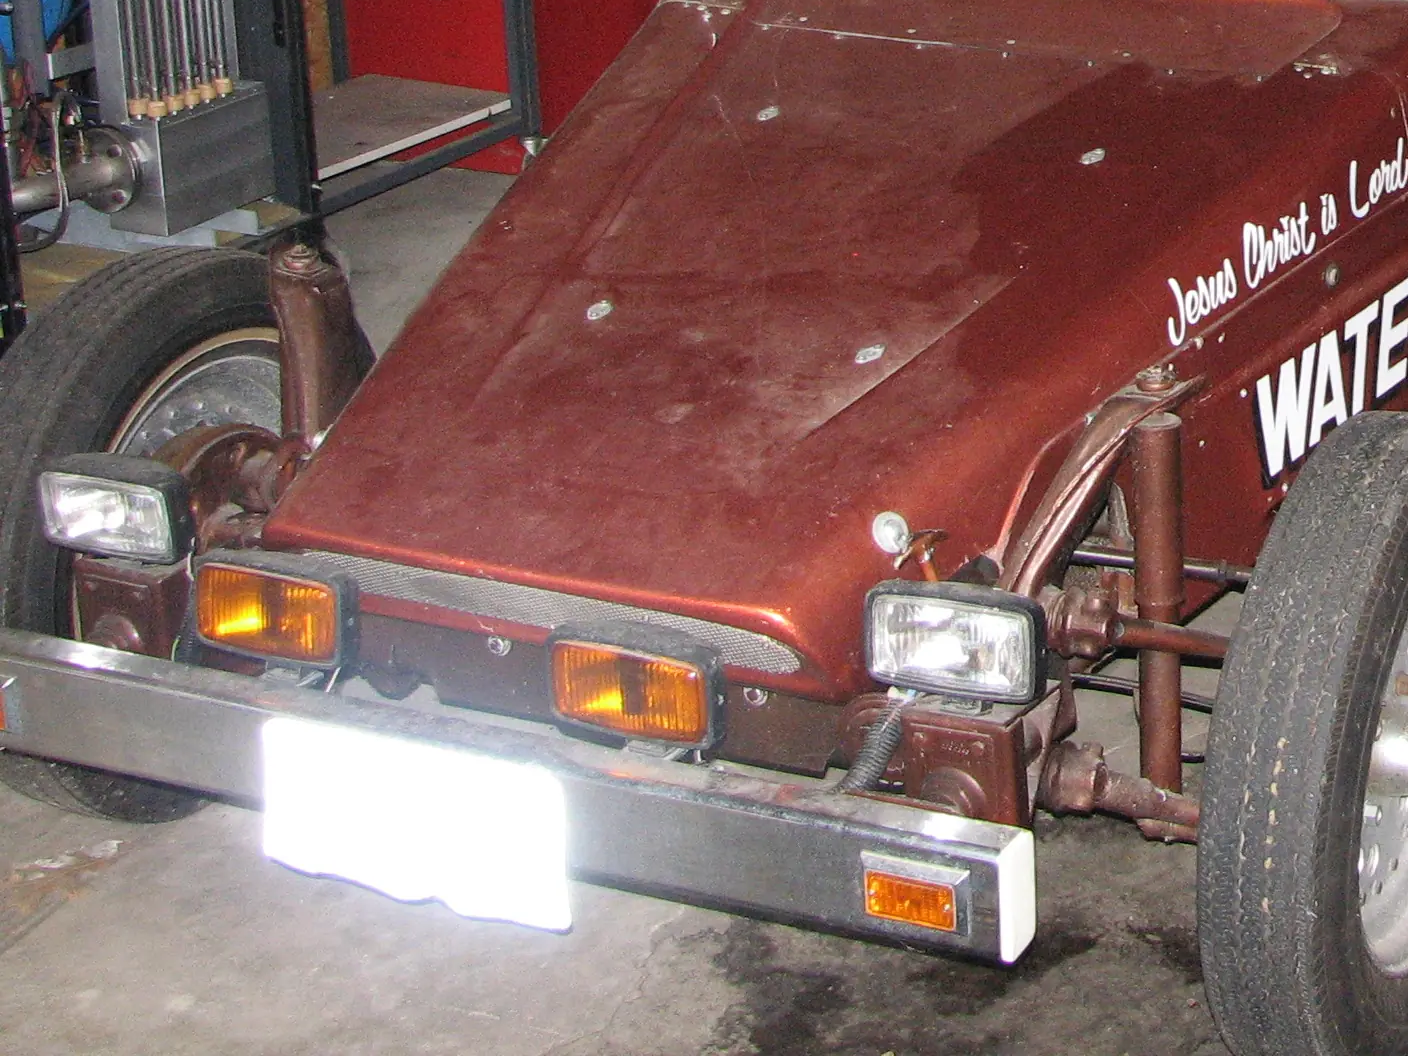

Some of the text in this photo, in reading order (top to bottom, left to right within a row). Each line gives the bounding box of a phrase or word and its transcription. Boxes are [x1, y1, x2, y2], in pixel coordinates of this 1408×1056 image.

[1168, 257, 1238, 346] Jesus
[1242, 201, 1316, 289] Christ
[1319, 193, 1338, 236] is
